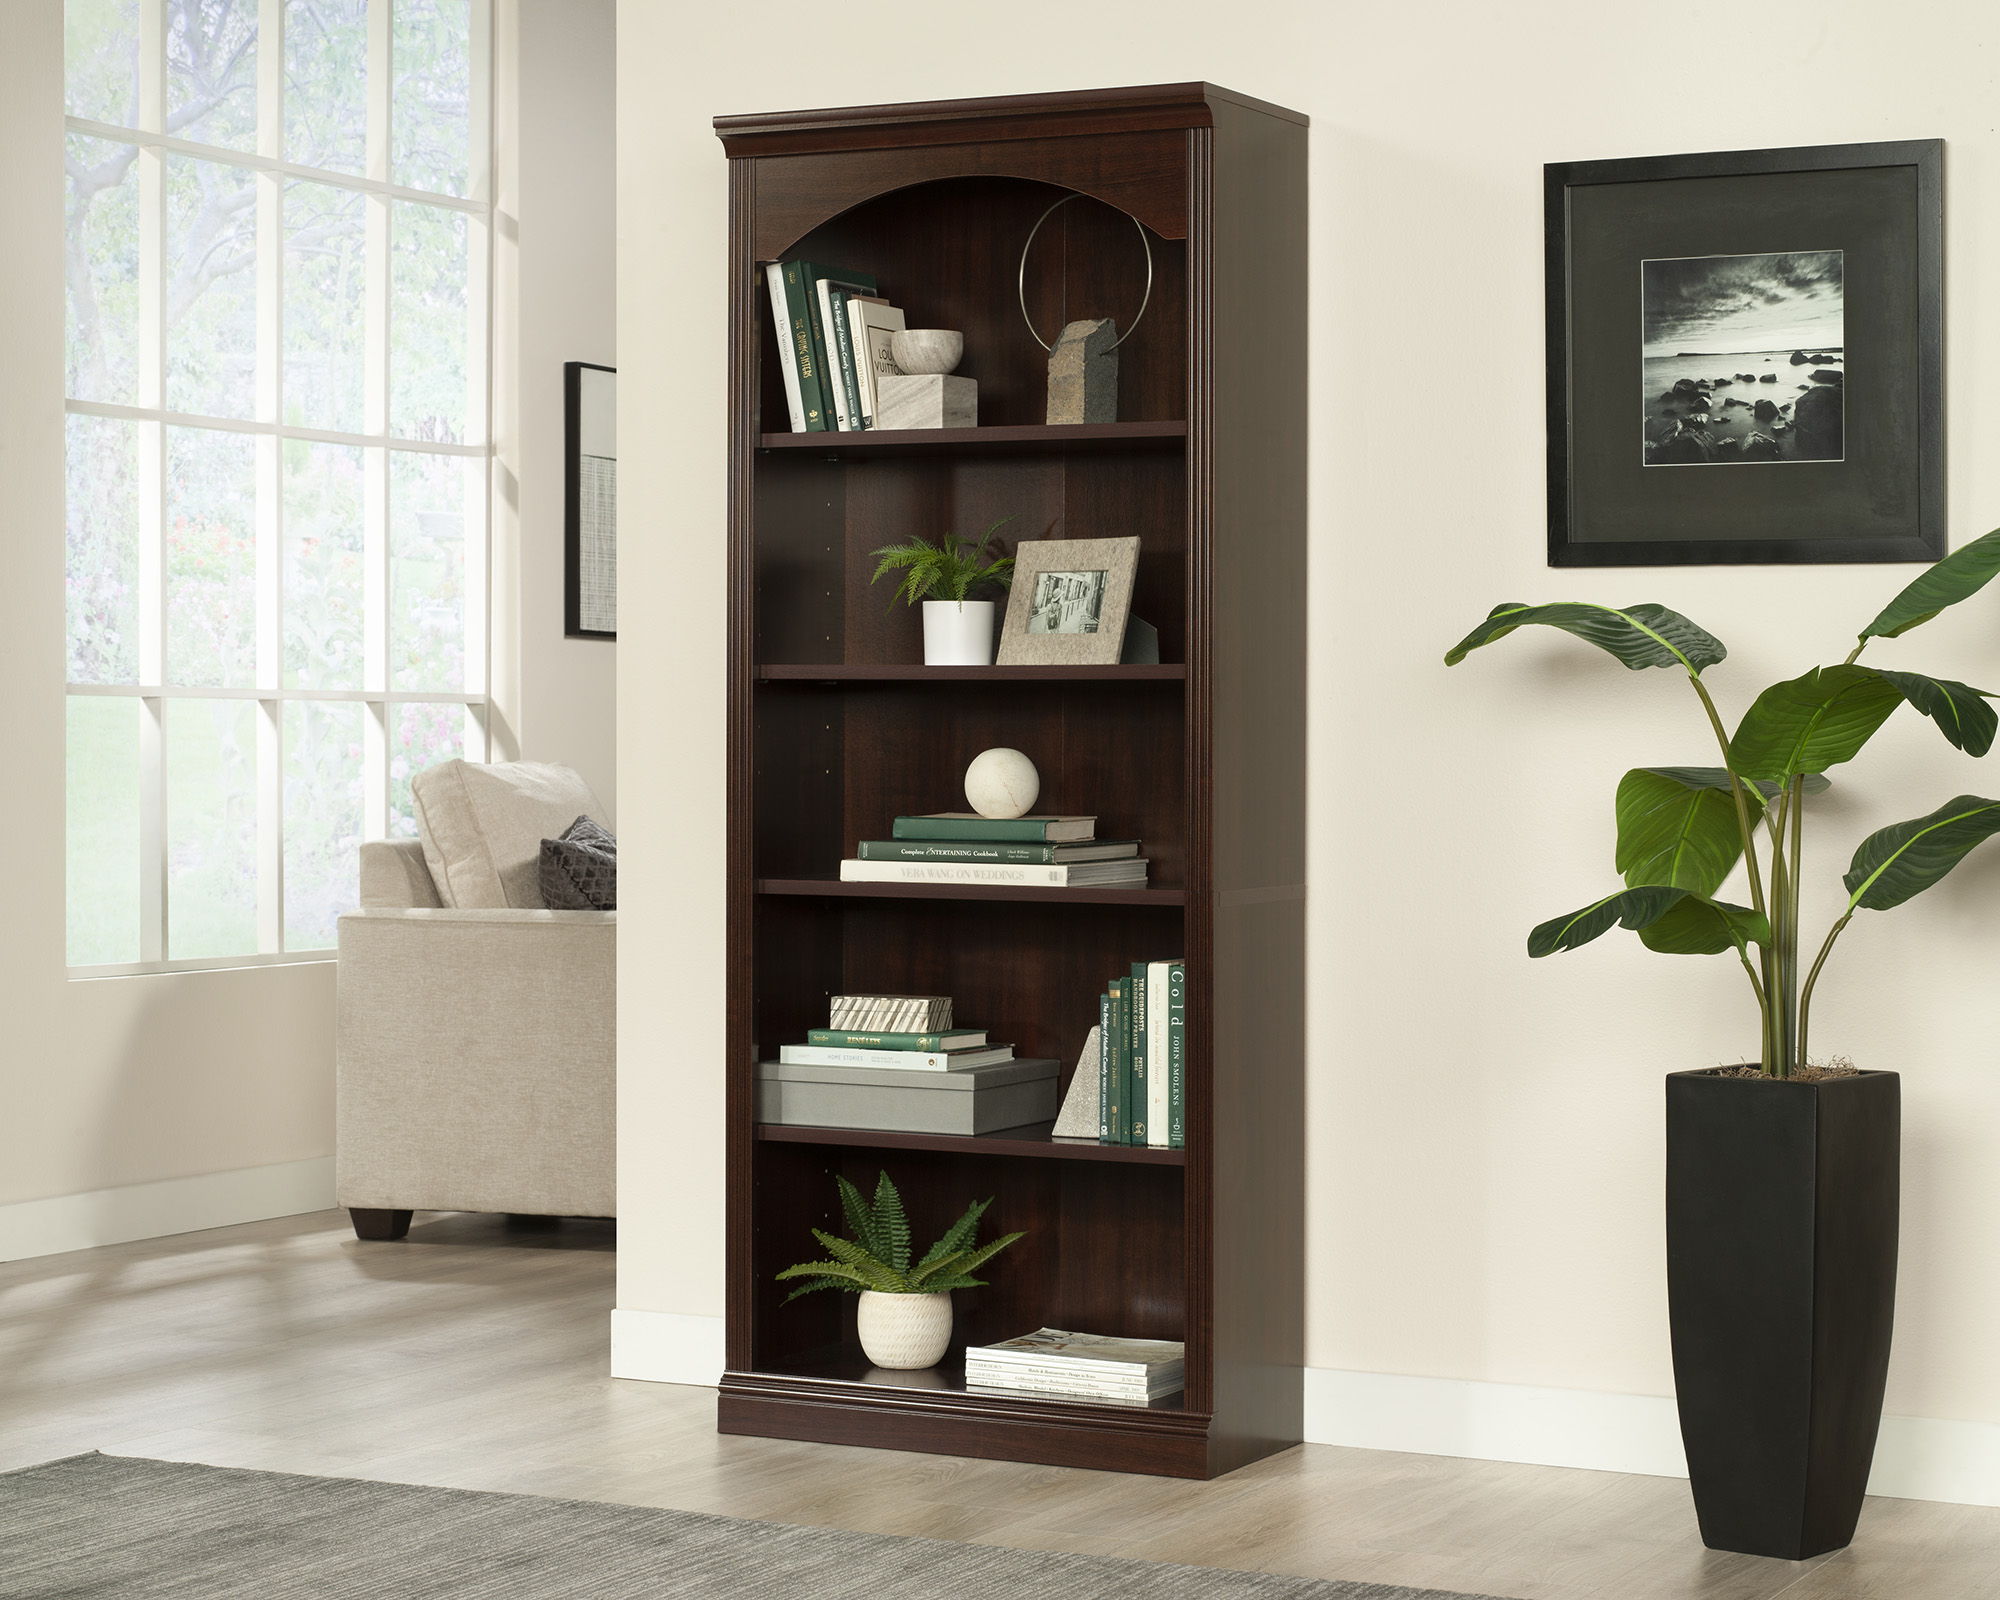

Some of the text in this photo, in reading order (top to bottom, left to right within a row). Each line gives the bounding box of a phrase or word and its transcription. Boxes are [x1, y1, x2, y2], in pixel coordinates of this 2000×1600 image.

[878, 349, 894, 361] LOU
[800, 355, 812, 378] SISTERS
[857, 358, 866, 387] VUITTON
[900, 848, 925, 856] Complete
[926, 846, 972, 857] ENTERTAINING
[900, 867, 1025, 880] VERA WANG ON WEDDINGS
[1171, 970, 1184, 1026] Cold
